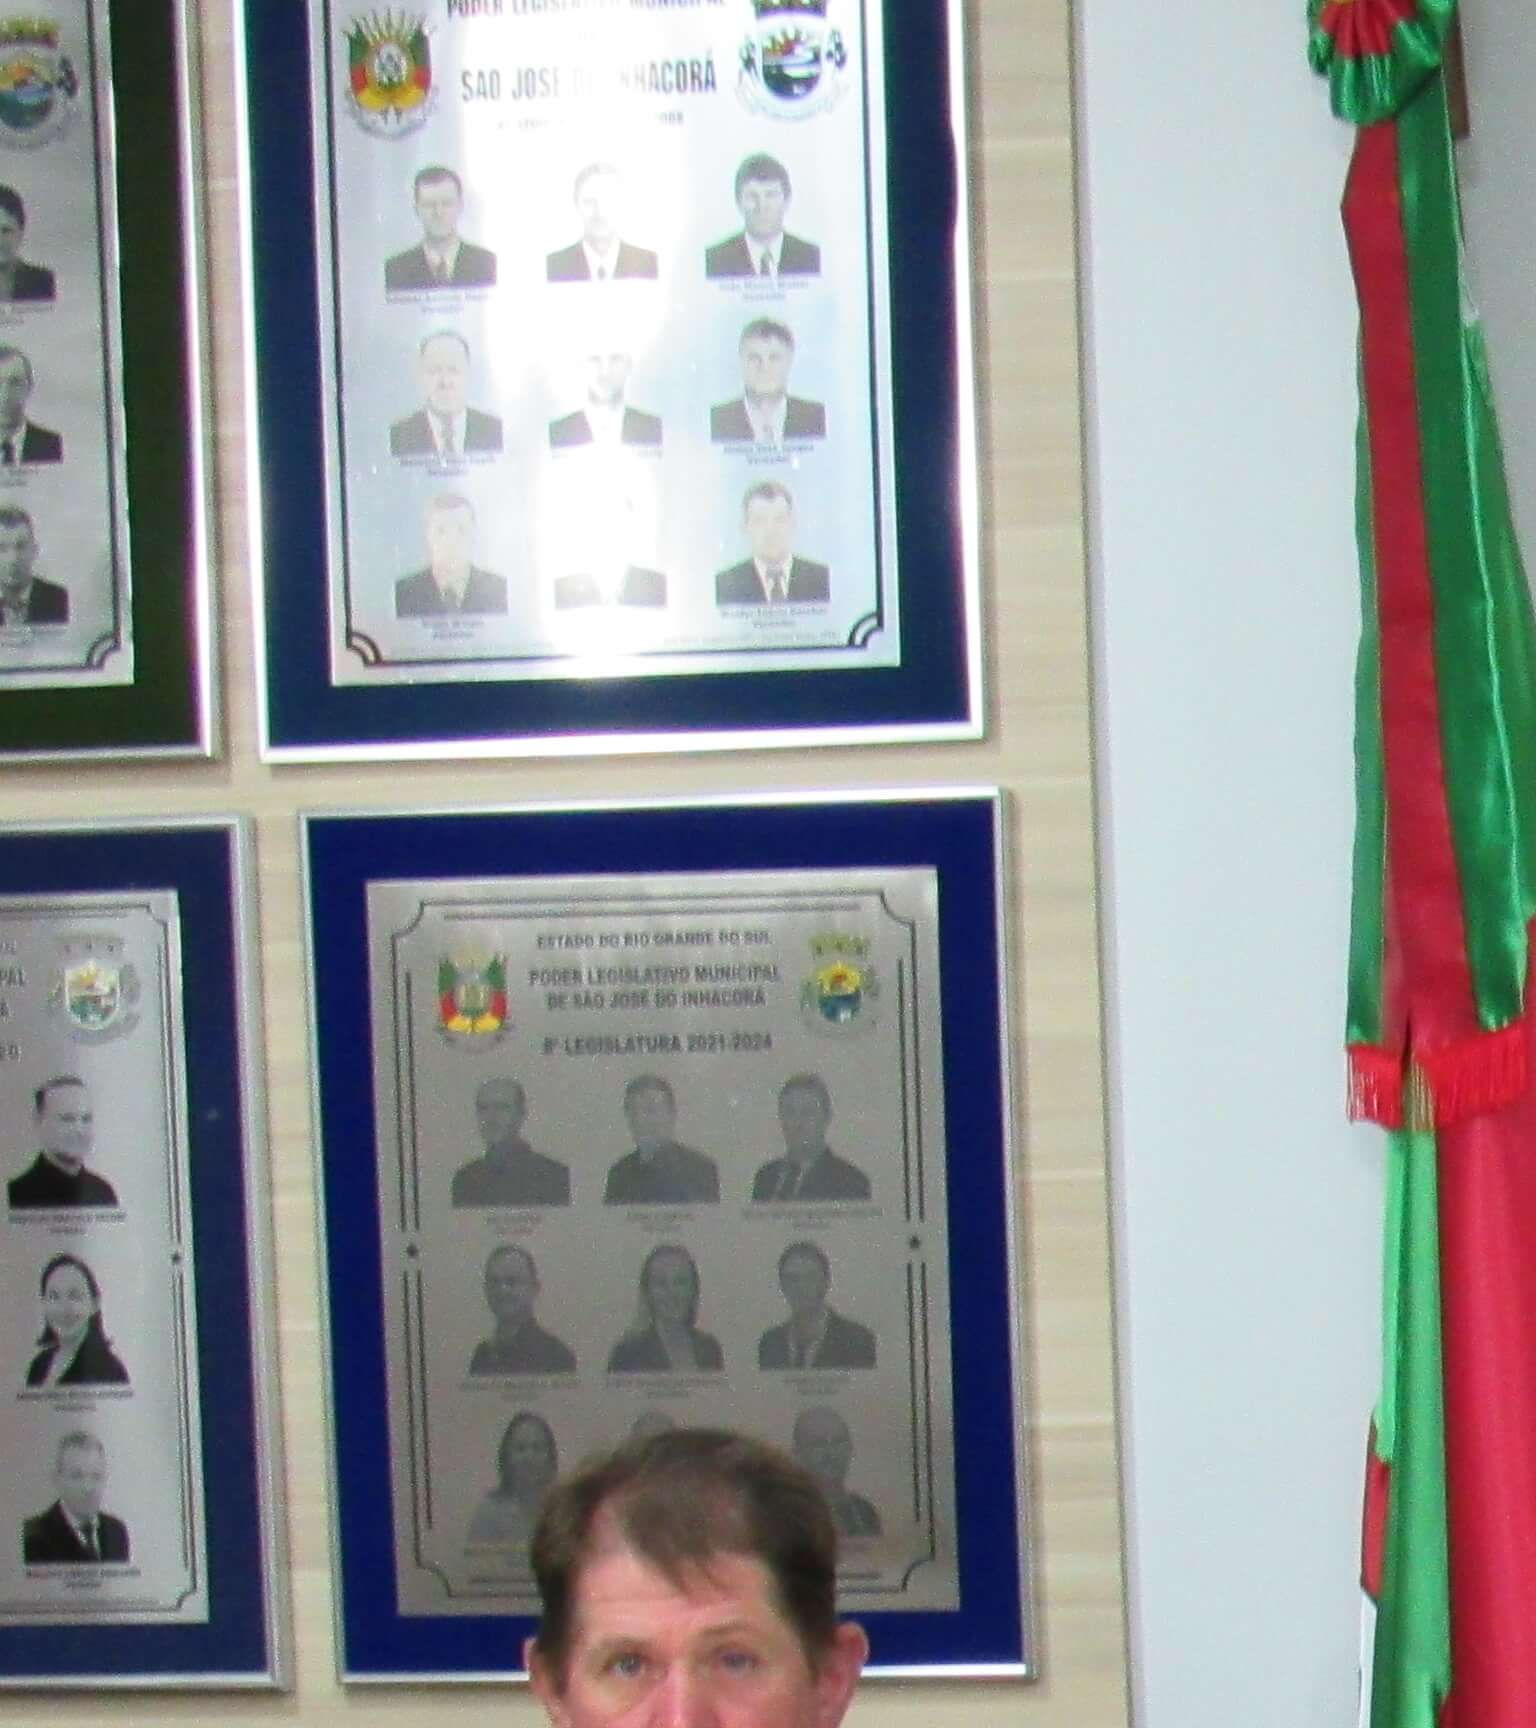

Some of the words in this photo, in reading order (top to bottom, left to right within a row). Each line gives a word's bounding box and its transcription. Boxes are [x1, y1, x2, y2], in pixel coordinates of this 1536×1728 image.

[587, 965, 690, 985] LEGISLATIVO
[694, 961, 783, 983] MUNICIPAL
[564, 1033, 682, 1054] LEGISLATURA
